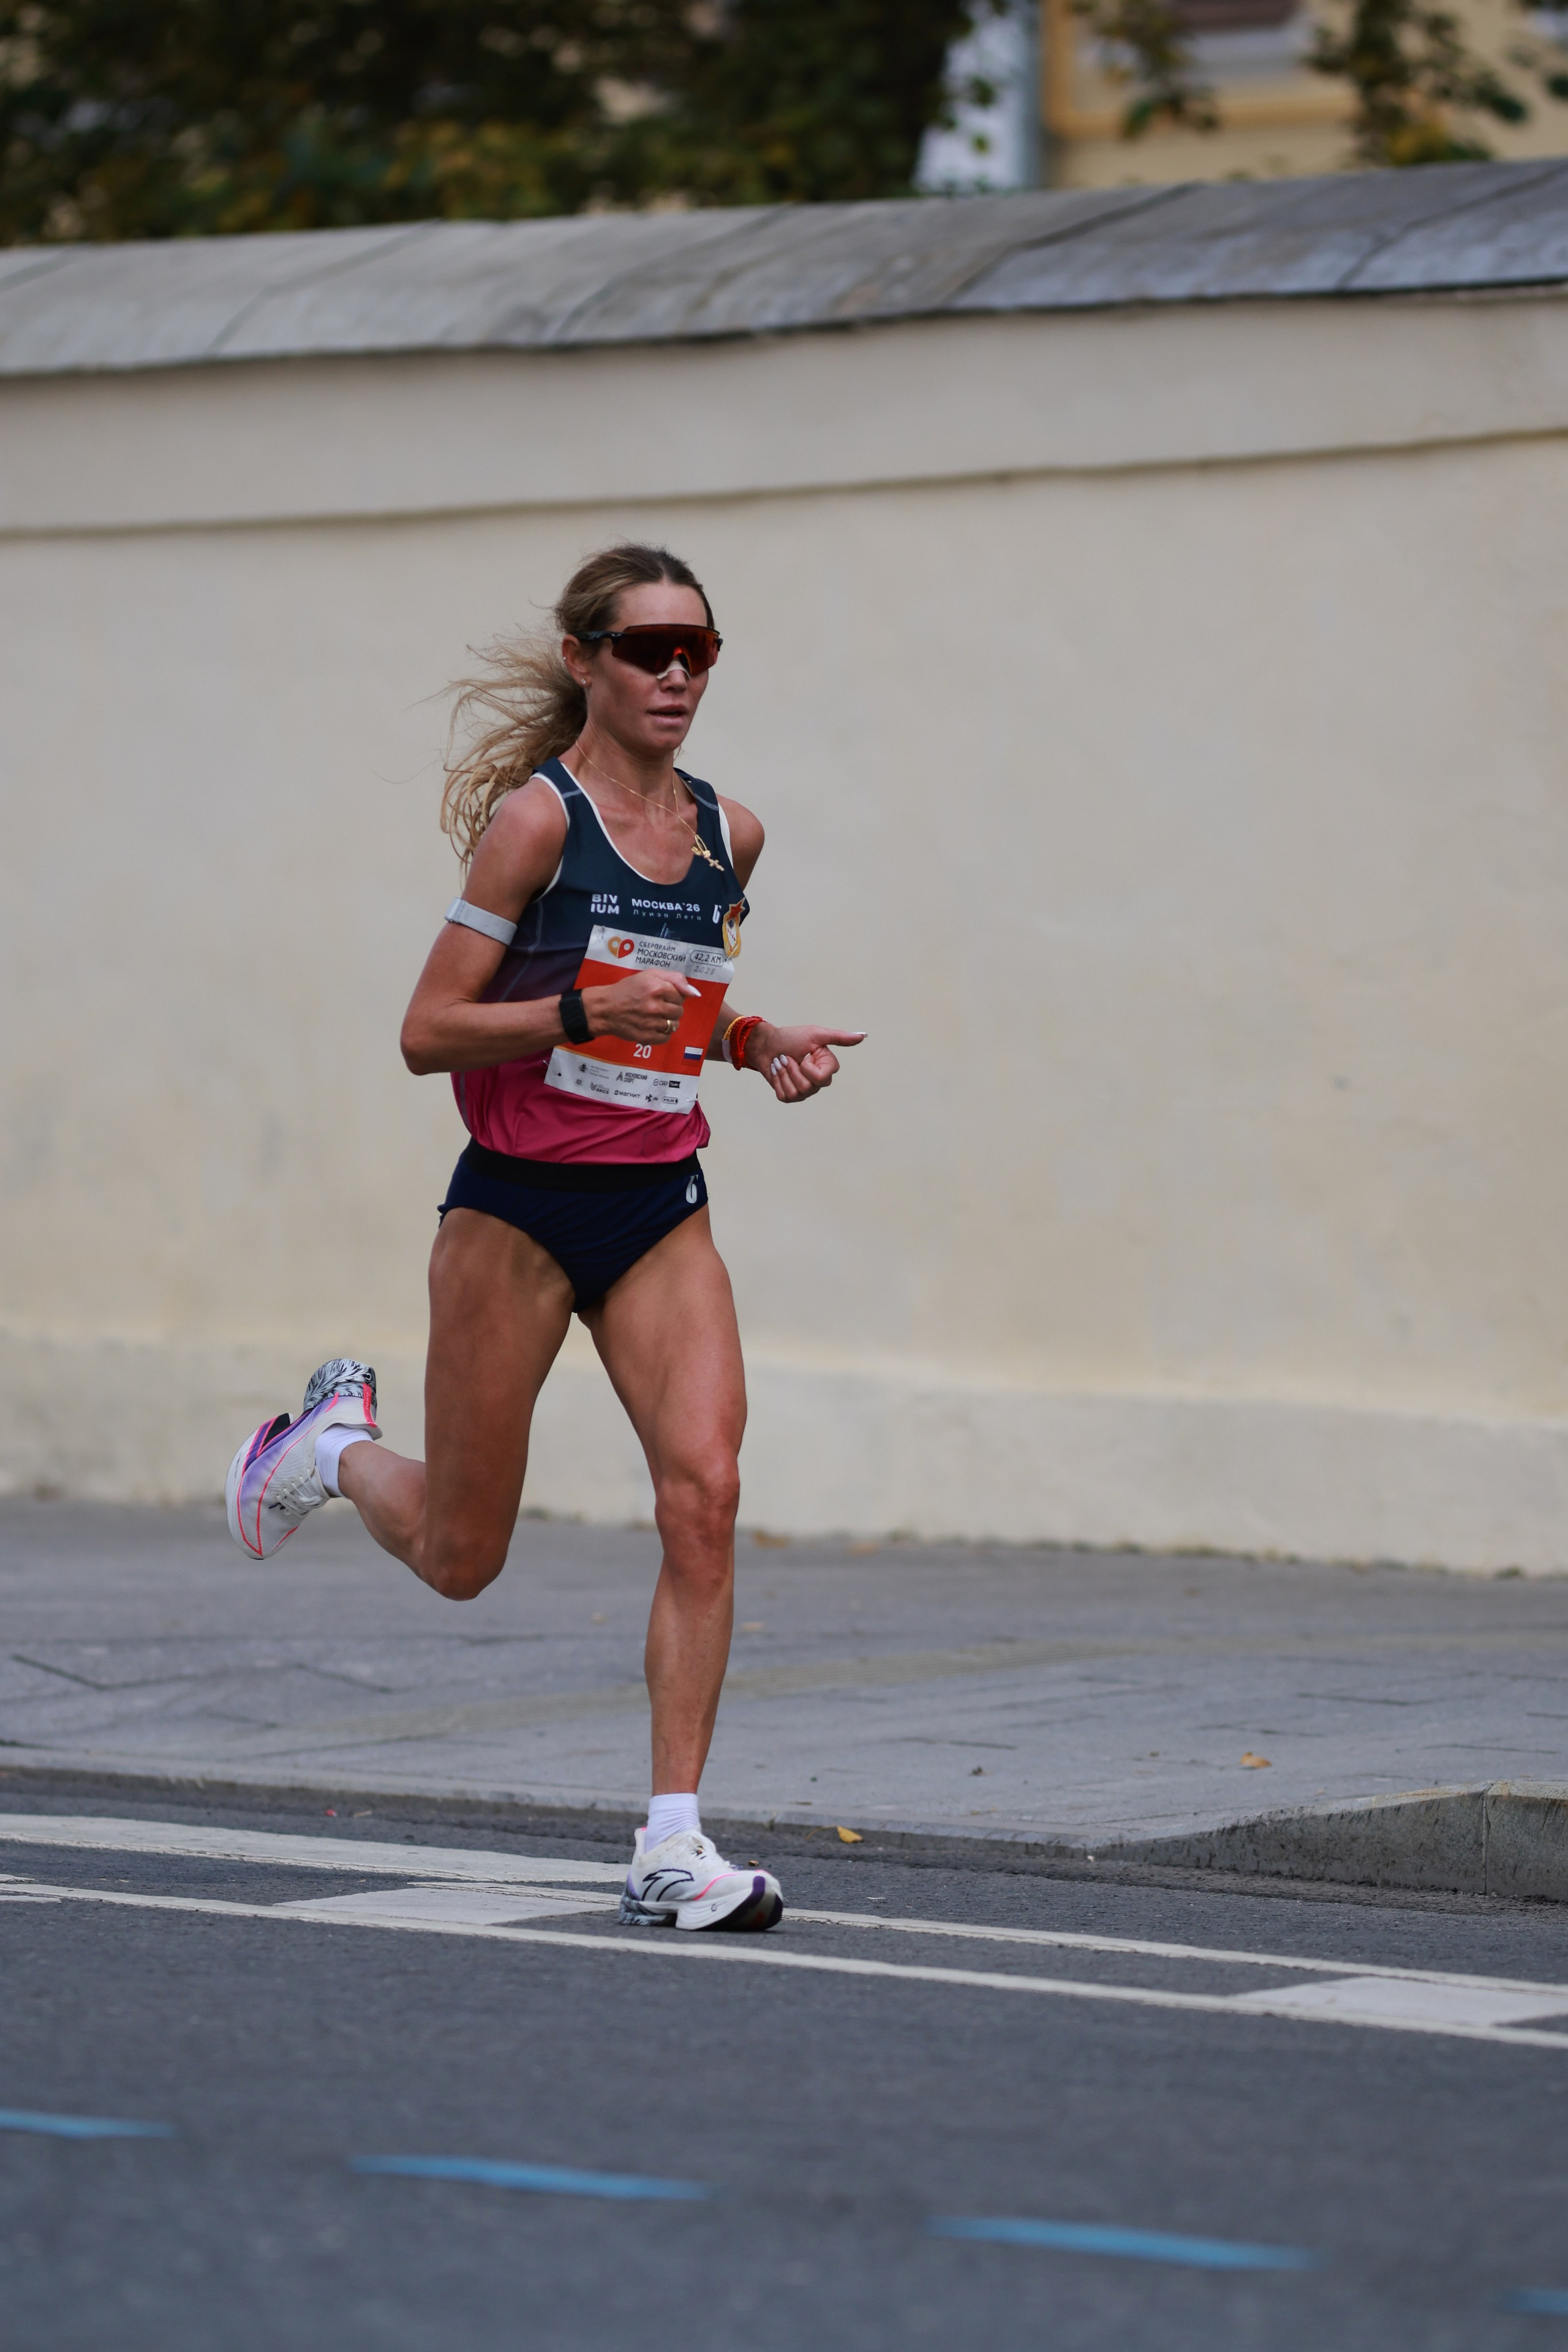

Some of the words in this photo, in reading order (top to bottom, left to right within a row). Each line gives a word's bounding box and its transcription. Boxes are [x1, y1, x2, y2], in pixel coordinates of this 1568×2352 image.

[591, 894, 618, 904] BIV
[590, 903, 620, 914] IUM
[633, 909, 669, 919] Луиза
[639, 941, 676, 952] СБЕРПРАЙМ
[637, 948, 686, 962] МОСКОВСКИЙ
[694, 952, 710, 962] 42,2
[635, 956, 671, 968] МАРАФОН
[633, 1043, 652, 1059] 20
